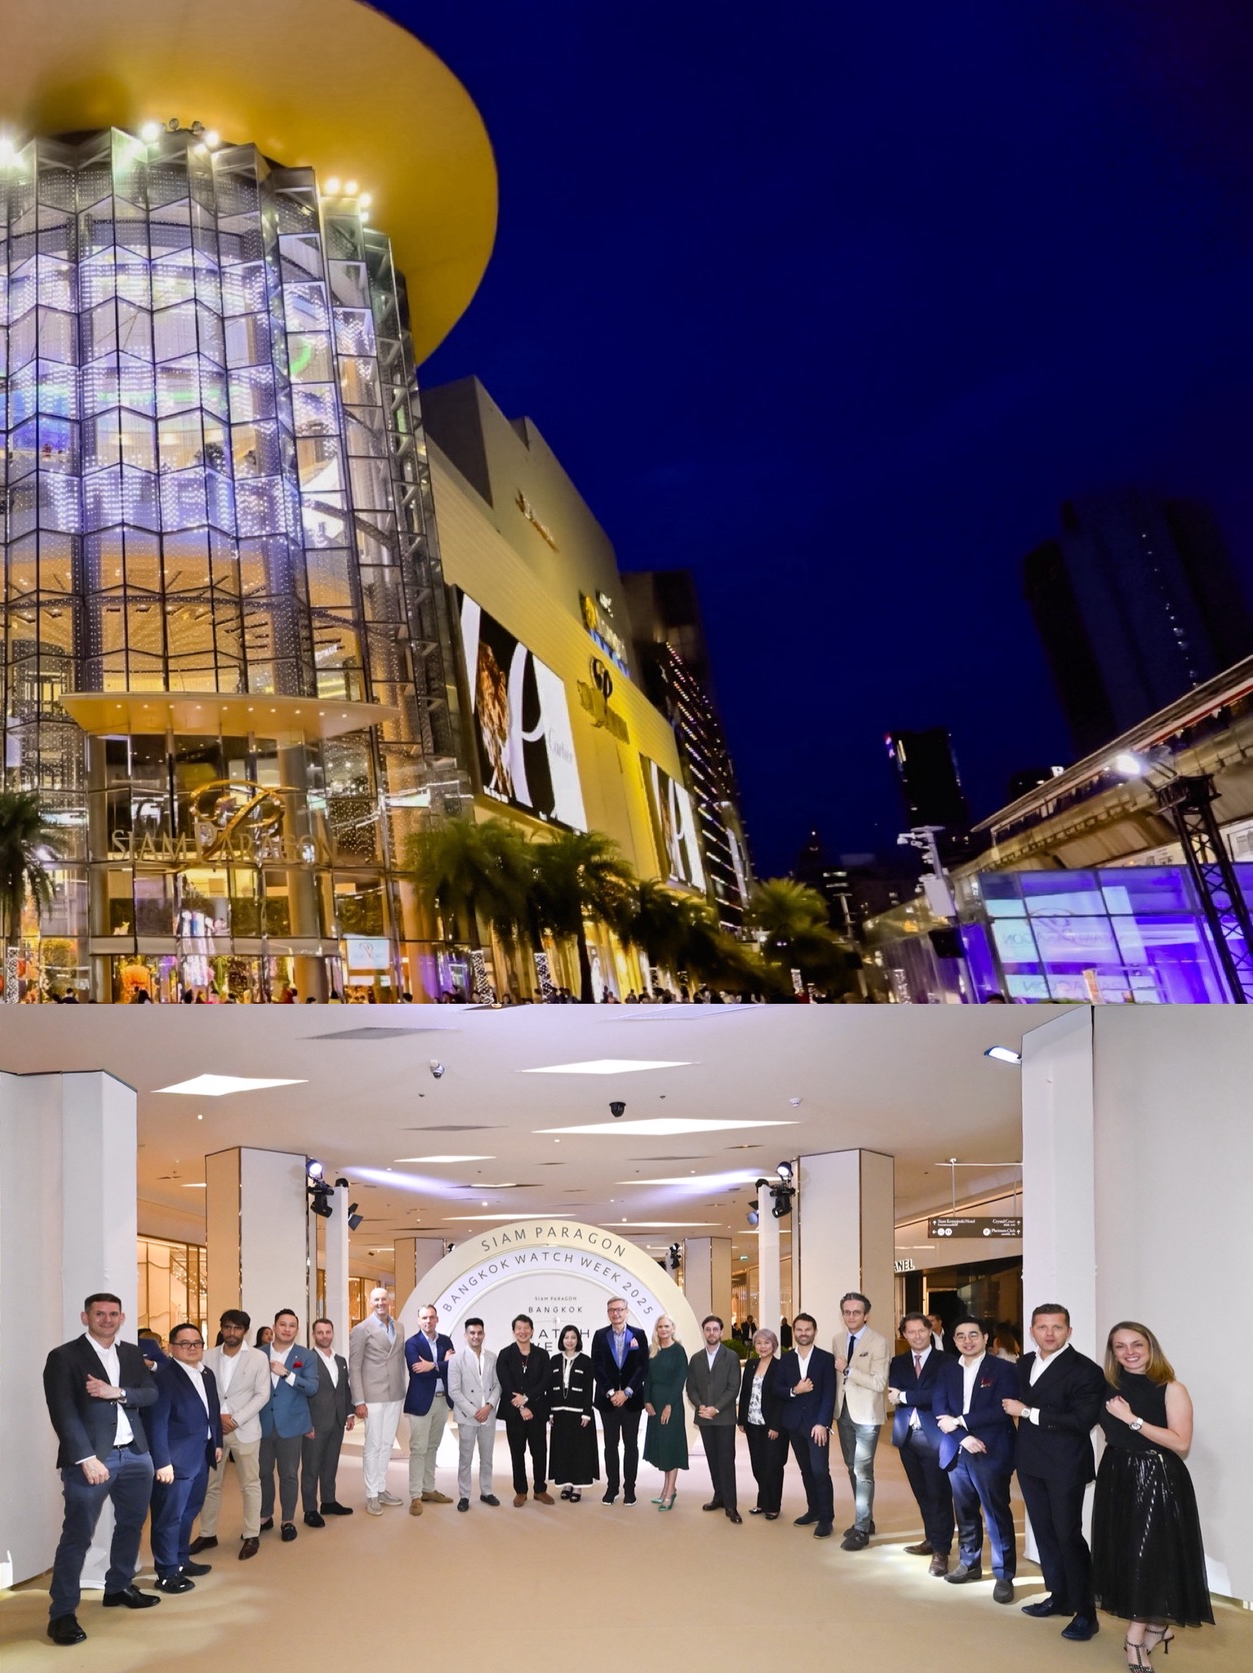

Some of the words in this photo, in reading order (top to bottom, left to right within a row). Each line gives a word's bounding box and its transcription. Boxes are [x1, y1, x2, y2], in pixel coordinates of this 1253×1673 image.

[111, 828, 187, 864] SIAM
[195, 821, 339, 868] PARAGON
[481, 1228, 526, 1252] SIAM
[535, 1226, 626, 1257] PARAGON
[443, 1258, 510, 1312] BANGKOK
[514, 1251, 574, 1265] WATCH
[580, 1256, 622, 1283] WEEK
[621, 1281, 654, 1315] 2025
[538, 1328, 590, 1339] ATH
